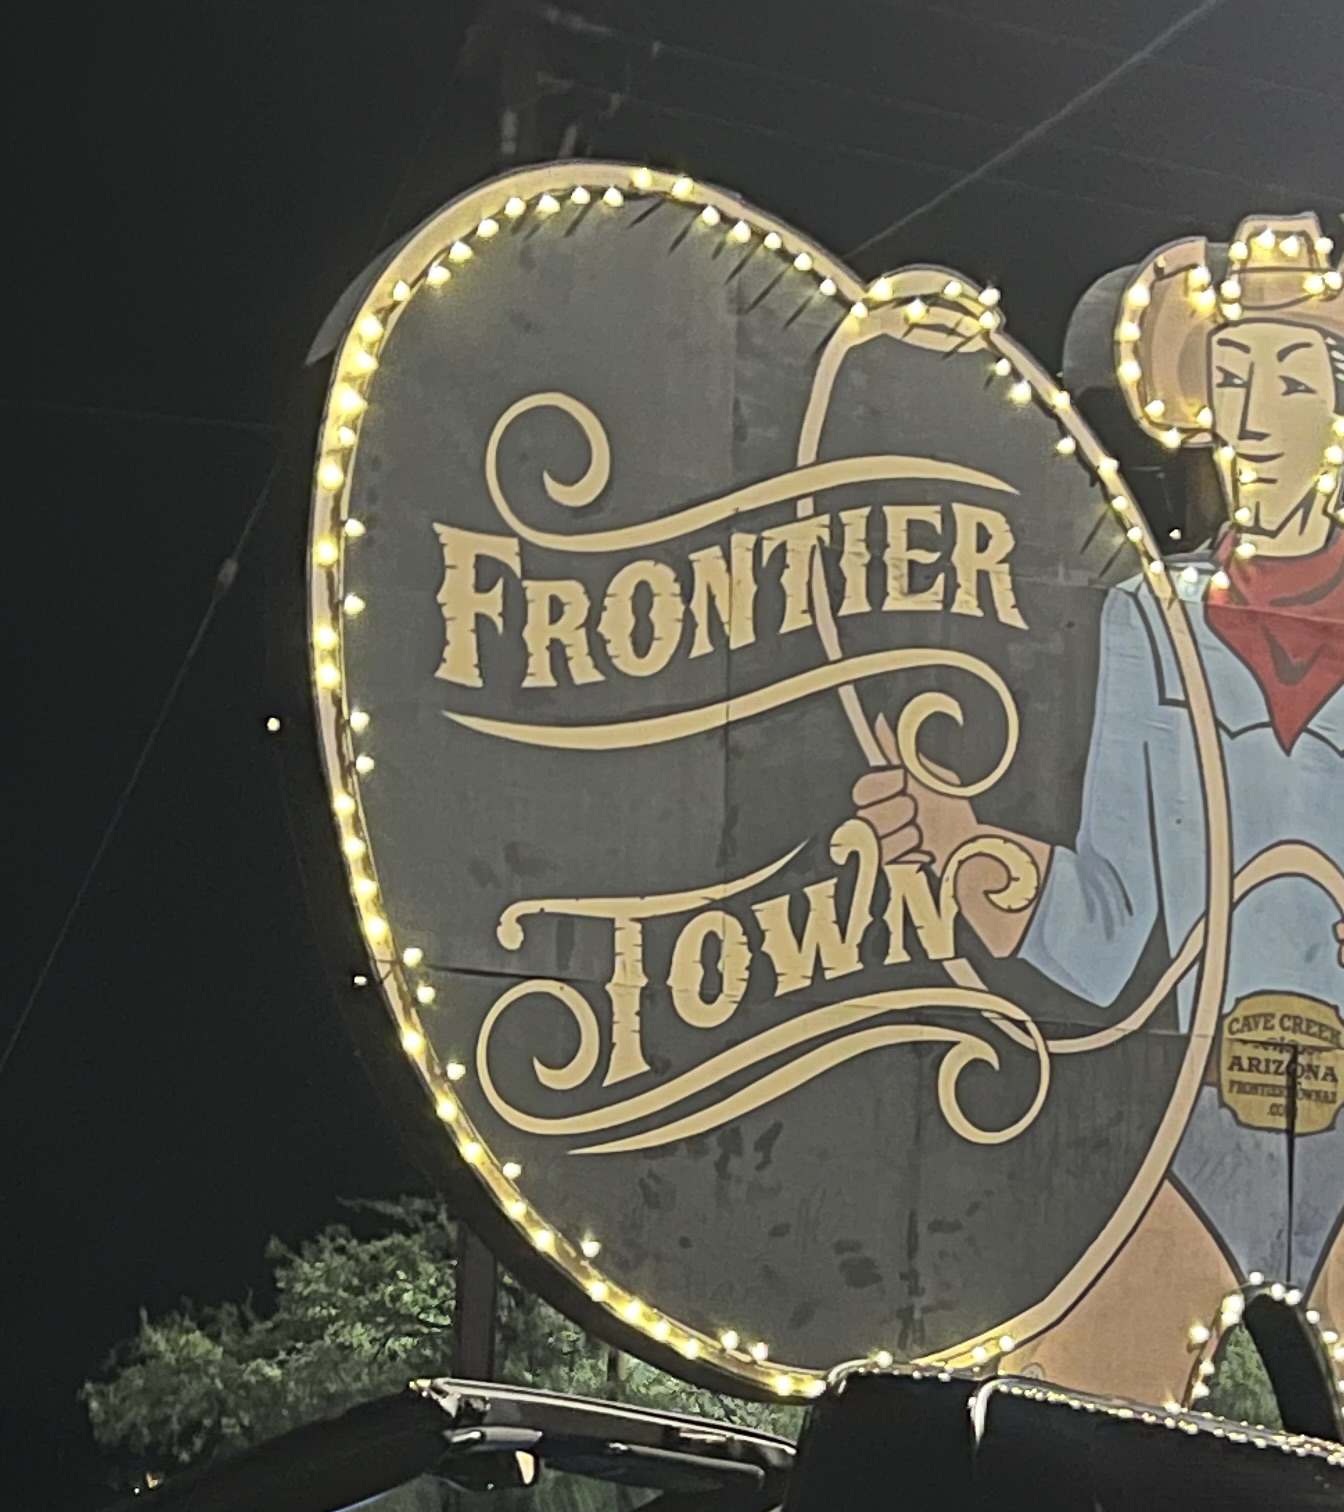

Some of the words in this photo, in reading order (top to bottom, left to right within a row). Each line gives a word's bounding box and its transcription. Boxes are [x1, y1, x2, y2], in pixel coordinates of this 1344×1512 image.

[432, 501, 1030, 689] FRONTIER
[496, 819, 1039, 1087] TOWN
[1227, 1012, 1275, 1036] CAVE
[1278, 1013, 1343, 1048] CREEK
[1227, 1055, 1339, 1083] ARIZONA
